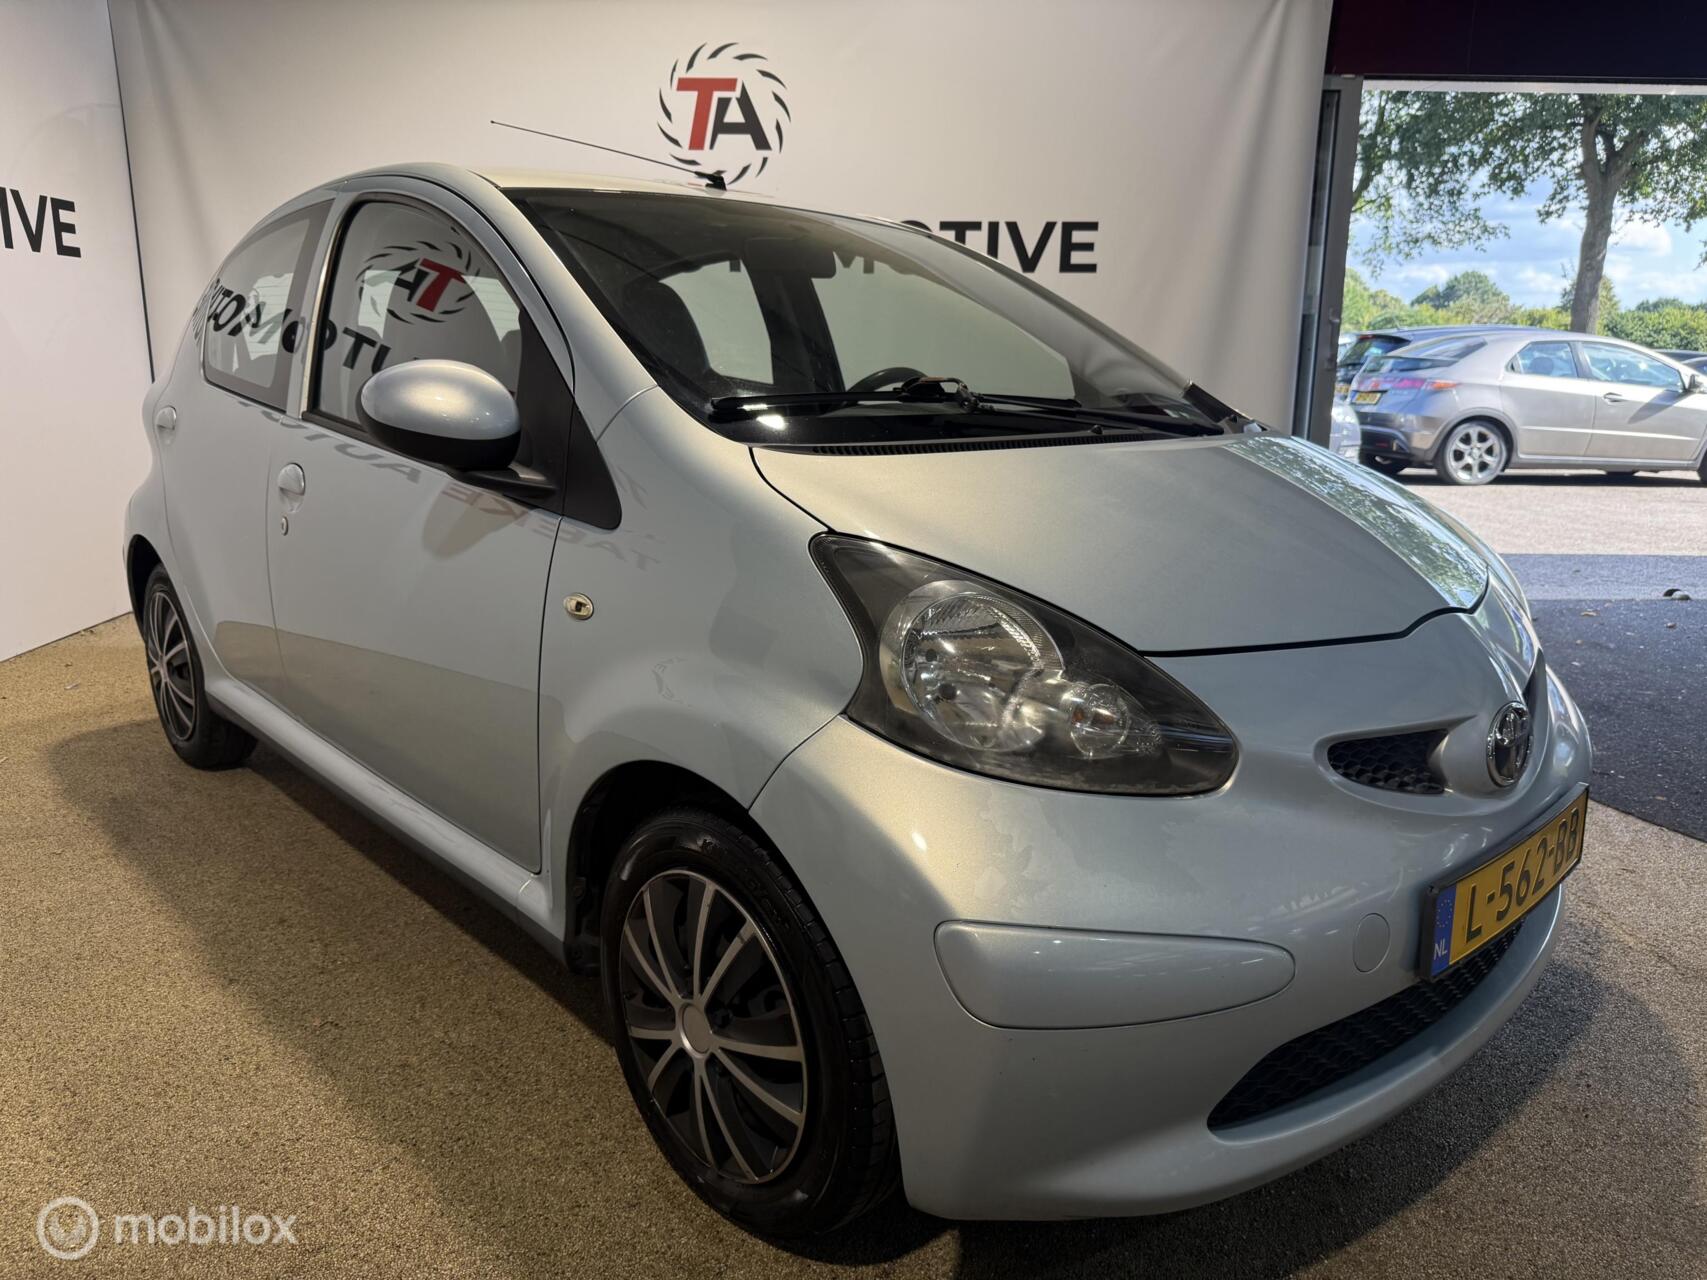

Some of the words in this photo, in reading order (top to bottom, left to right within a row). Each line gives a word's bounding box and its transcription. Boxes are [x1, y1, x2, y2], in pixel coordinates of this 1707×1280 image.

[676, 77, 772, 151] TA
[1433, 939, 1448, 961] NL
[1465, 807, 1580, 944] L-562-BB
